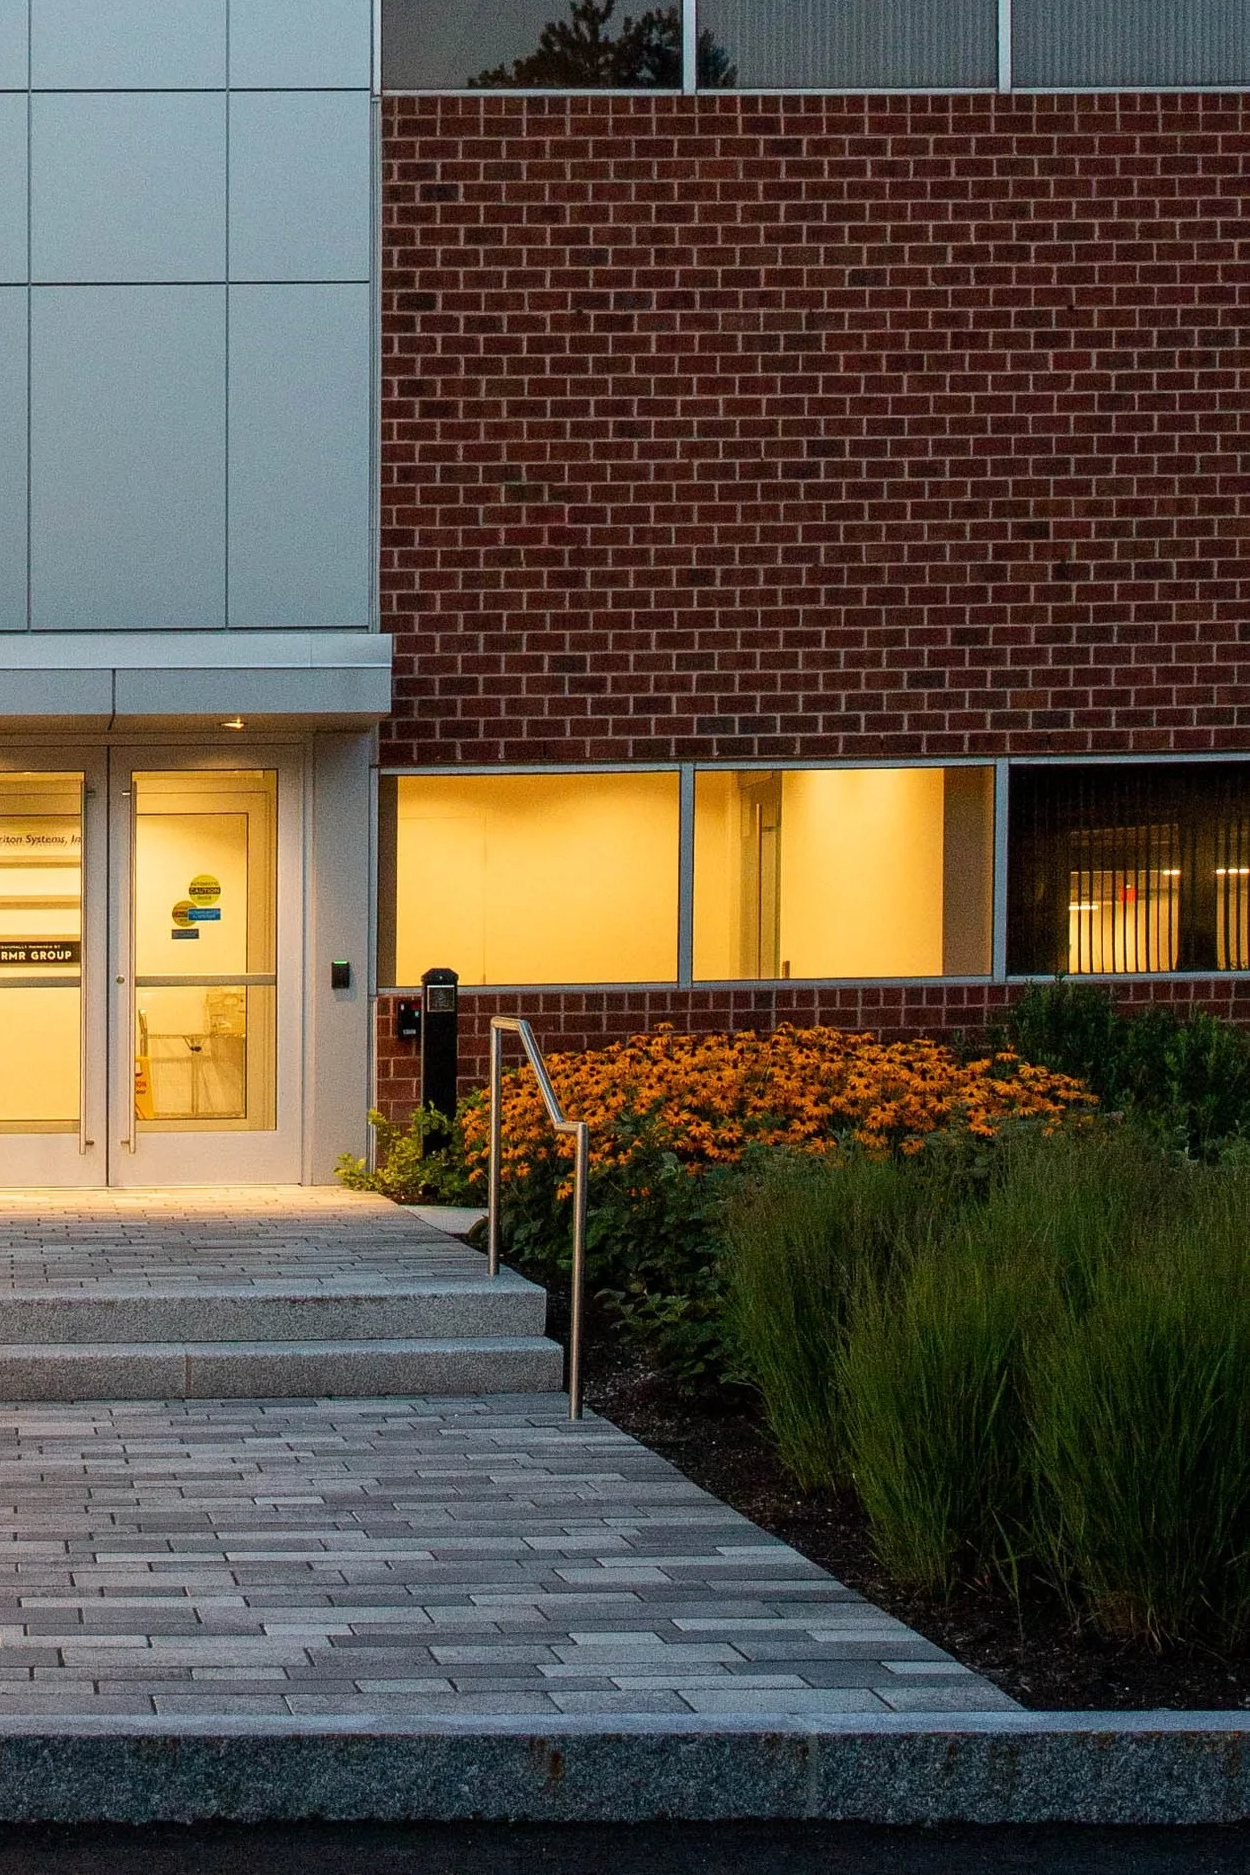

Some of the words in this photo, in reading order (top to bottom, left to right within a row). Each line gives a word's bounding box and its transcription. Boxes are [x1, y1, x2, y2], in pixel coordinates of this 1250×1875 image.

[25, 834, 67, 846] Systems,
[1, 951, 26, 961] RMR
[30, 950, 72, 960] GROUP
